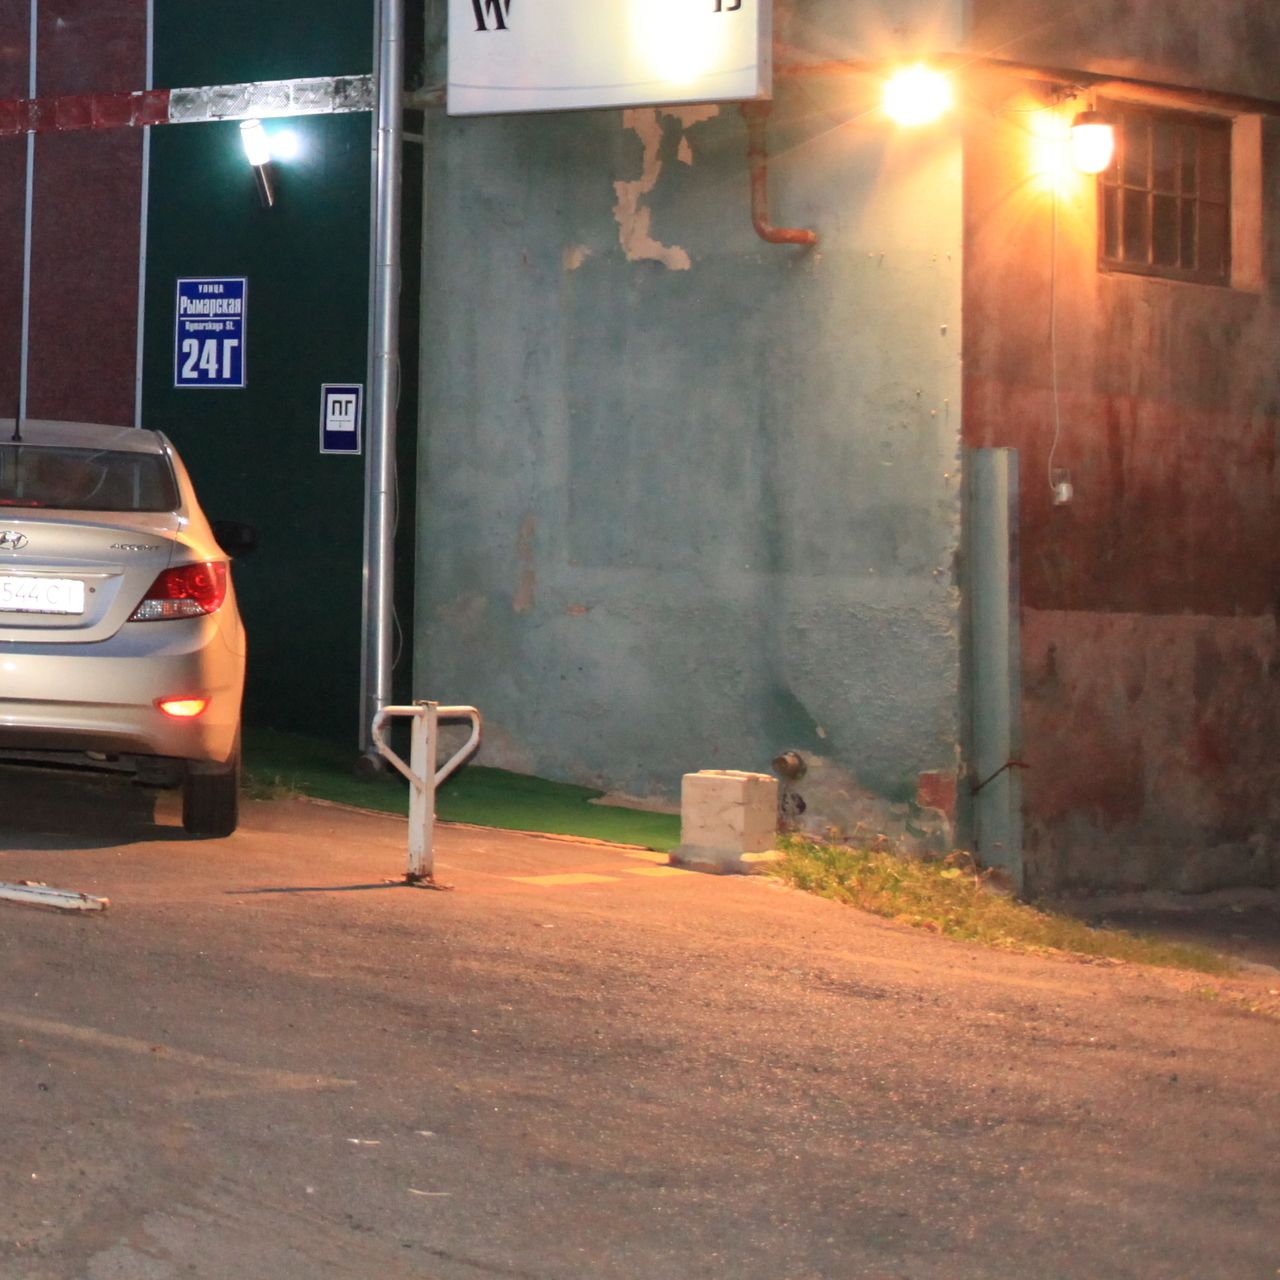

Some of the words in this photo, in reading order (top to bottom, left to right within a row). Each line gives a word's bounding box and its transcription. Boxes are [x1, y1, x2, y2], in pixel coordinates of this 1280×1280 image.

[180, 295, 241, 317] Рымарская
[181, 338, 239, 379] 24Г
[332, 400, 353, 416] ПГ
